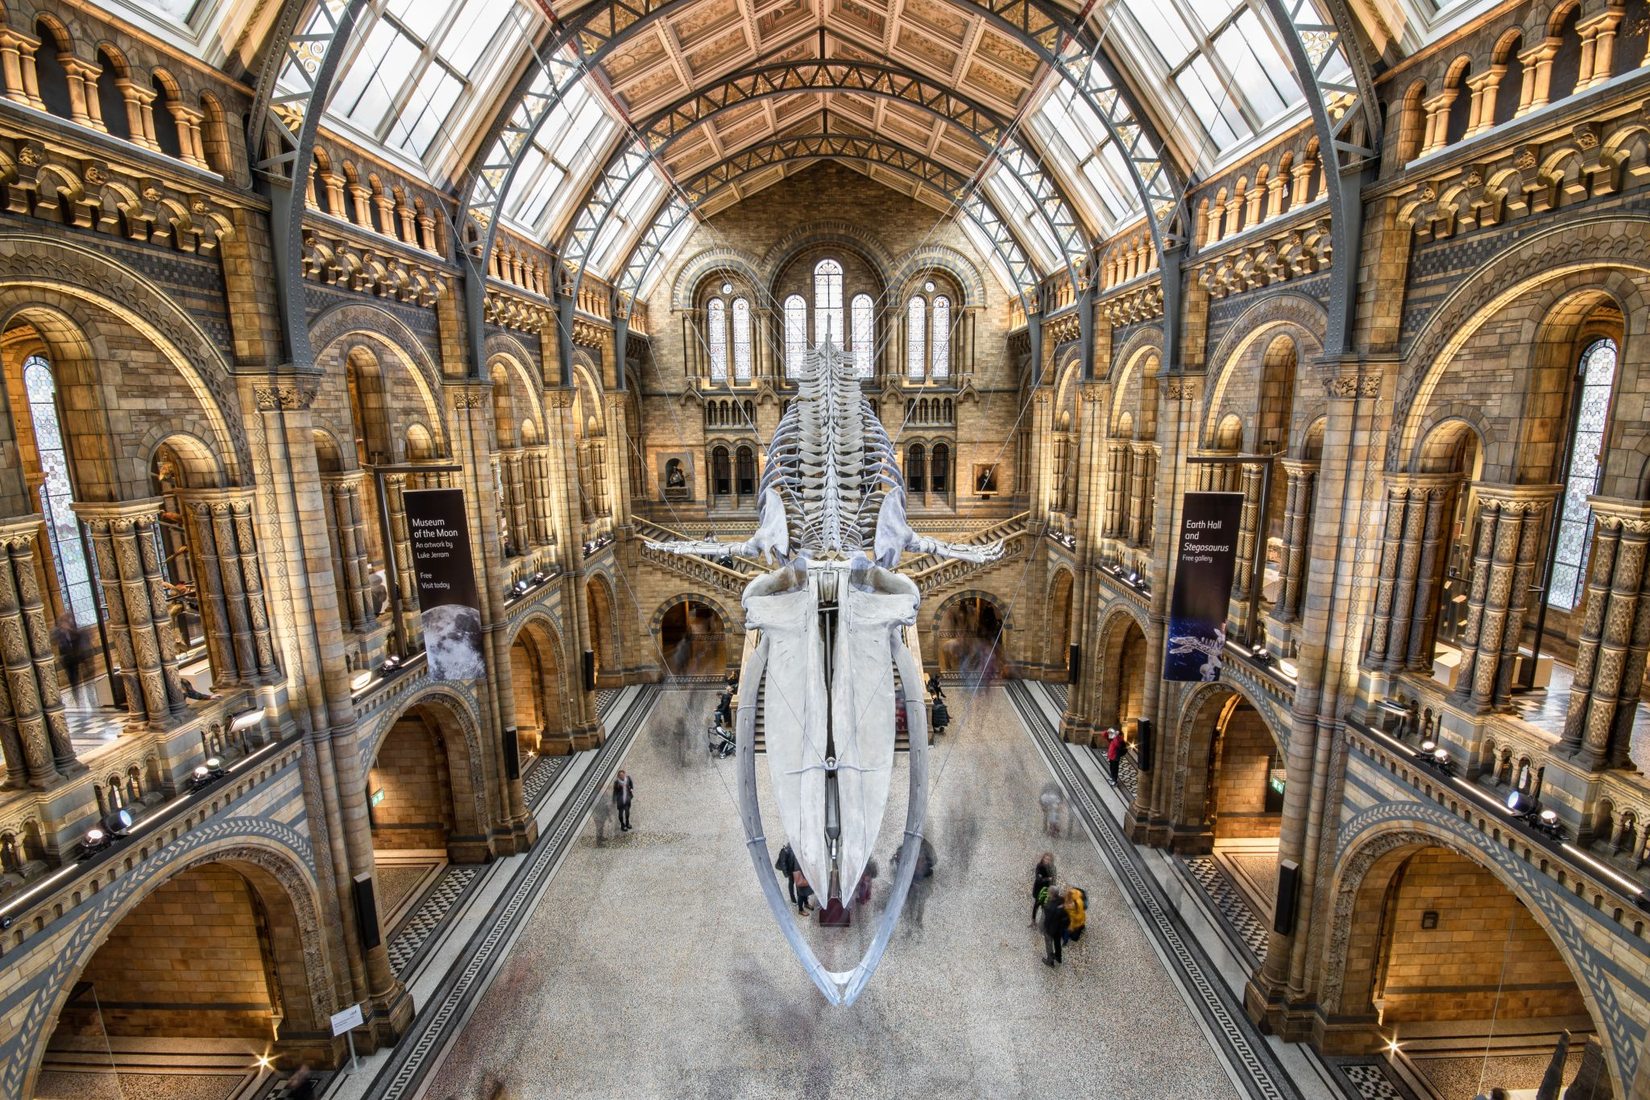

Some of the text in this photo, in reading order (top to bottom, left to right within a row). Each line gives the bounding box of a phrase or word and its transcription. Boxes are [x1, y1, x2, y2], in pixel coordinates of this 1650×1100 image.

[412, 518, 445, 527] Museum
[1186, 520, 1222, 529] Earth Hall
[414, 528, 458, 538] of the Moon
[1184, 531, 1200, 540] and
[446, 540, 454, 549] by
[1184, 542, 1230, 554] Stegosaurus
[1194, 554, 1213, 564] gallery
[434, 581, 450, 590] today
